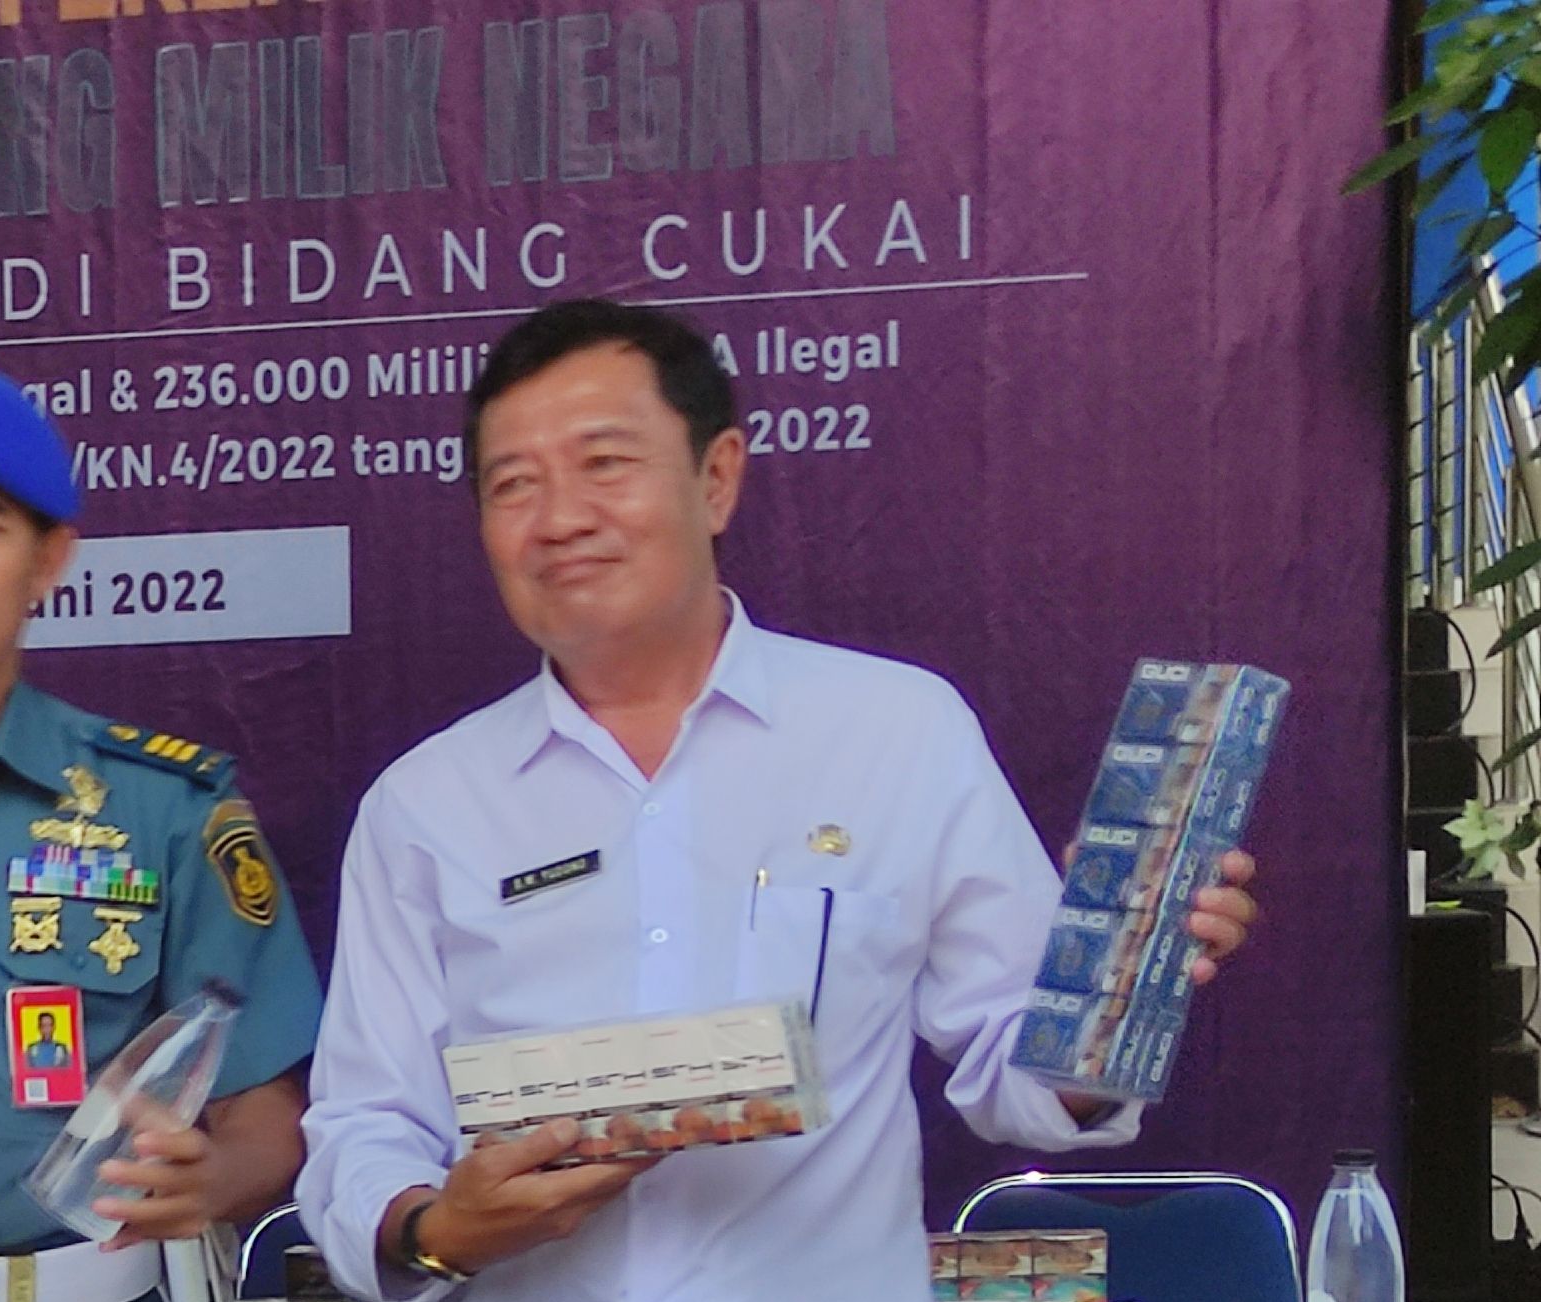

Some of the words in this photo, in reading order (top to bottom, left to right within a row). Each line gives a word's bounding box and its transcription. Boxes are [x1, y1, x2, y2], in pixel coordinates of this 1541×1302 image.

[155, 26, 447, 208] MILIK
[2, 253, 90, 322] DI
[167, 222, 567, 311] BIDANG
[641, 194, 972, 280] CUKAI
[110, 370, 138, 412] &
[152, 355, 350, 412] 236.000
[755, 321, 901, 382] Ilegal
[747, 404, 872, 454] 2022
[24, 572, 93, 620] uni
[111, 568, 226, 615] 2022
